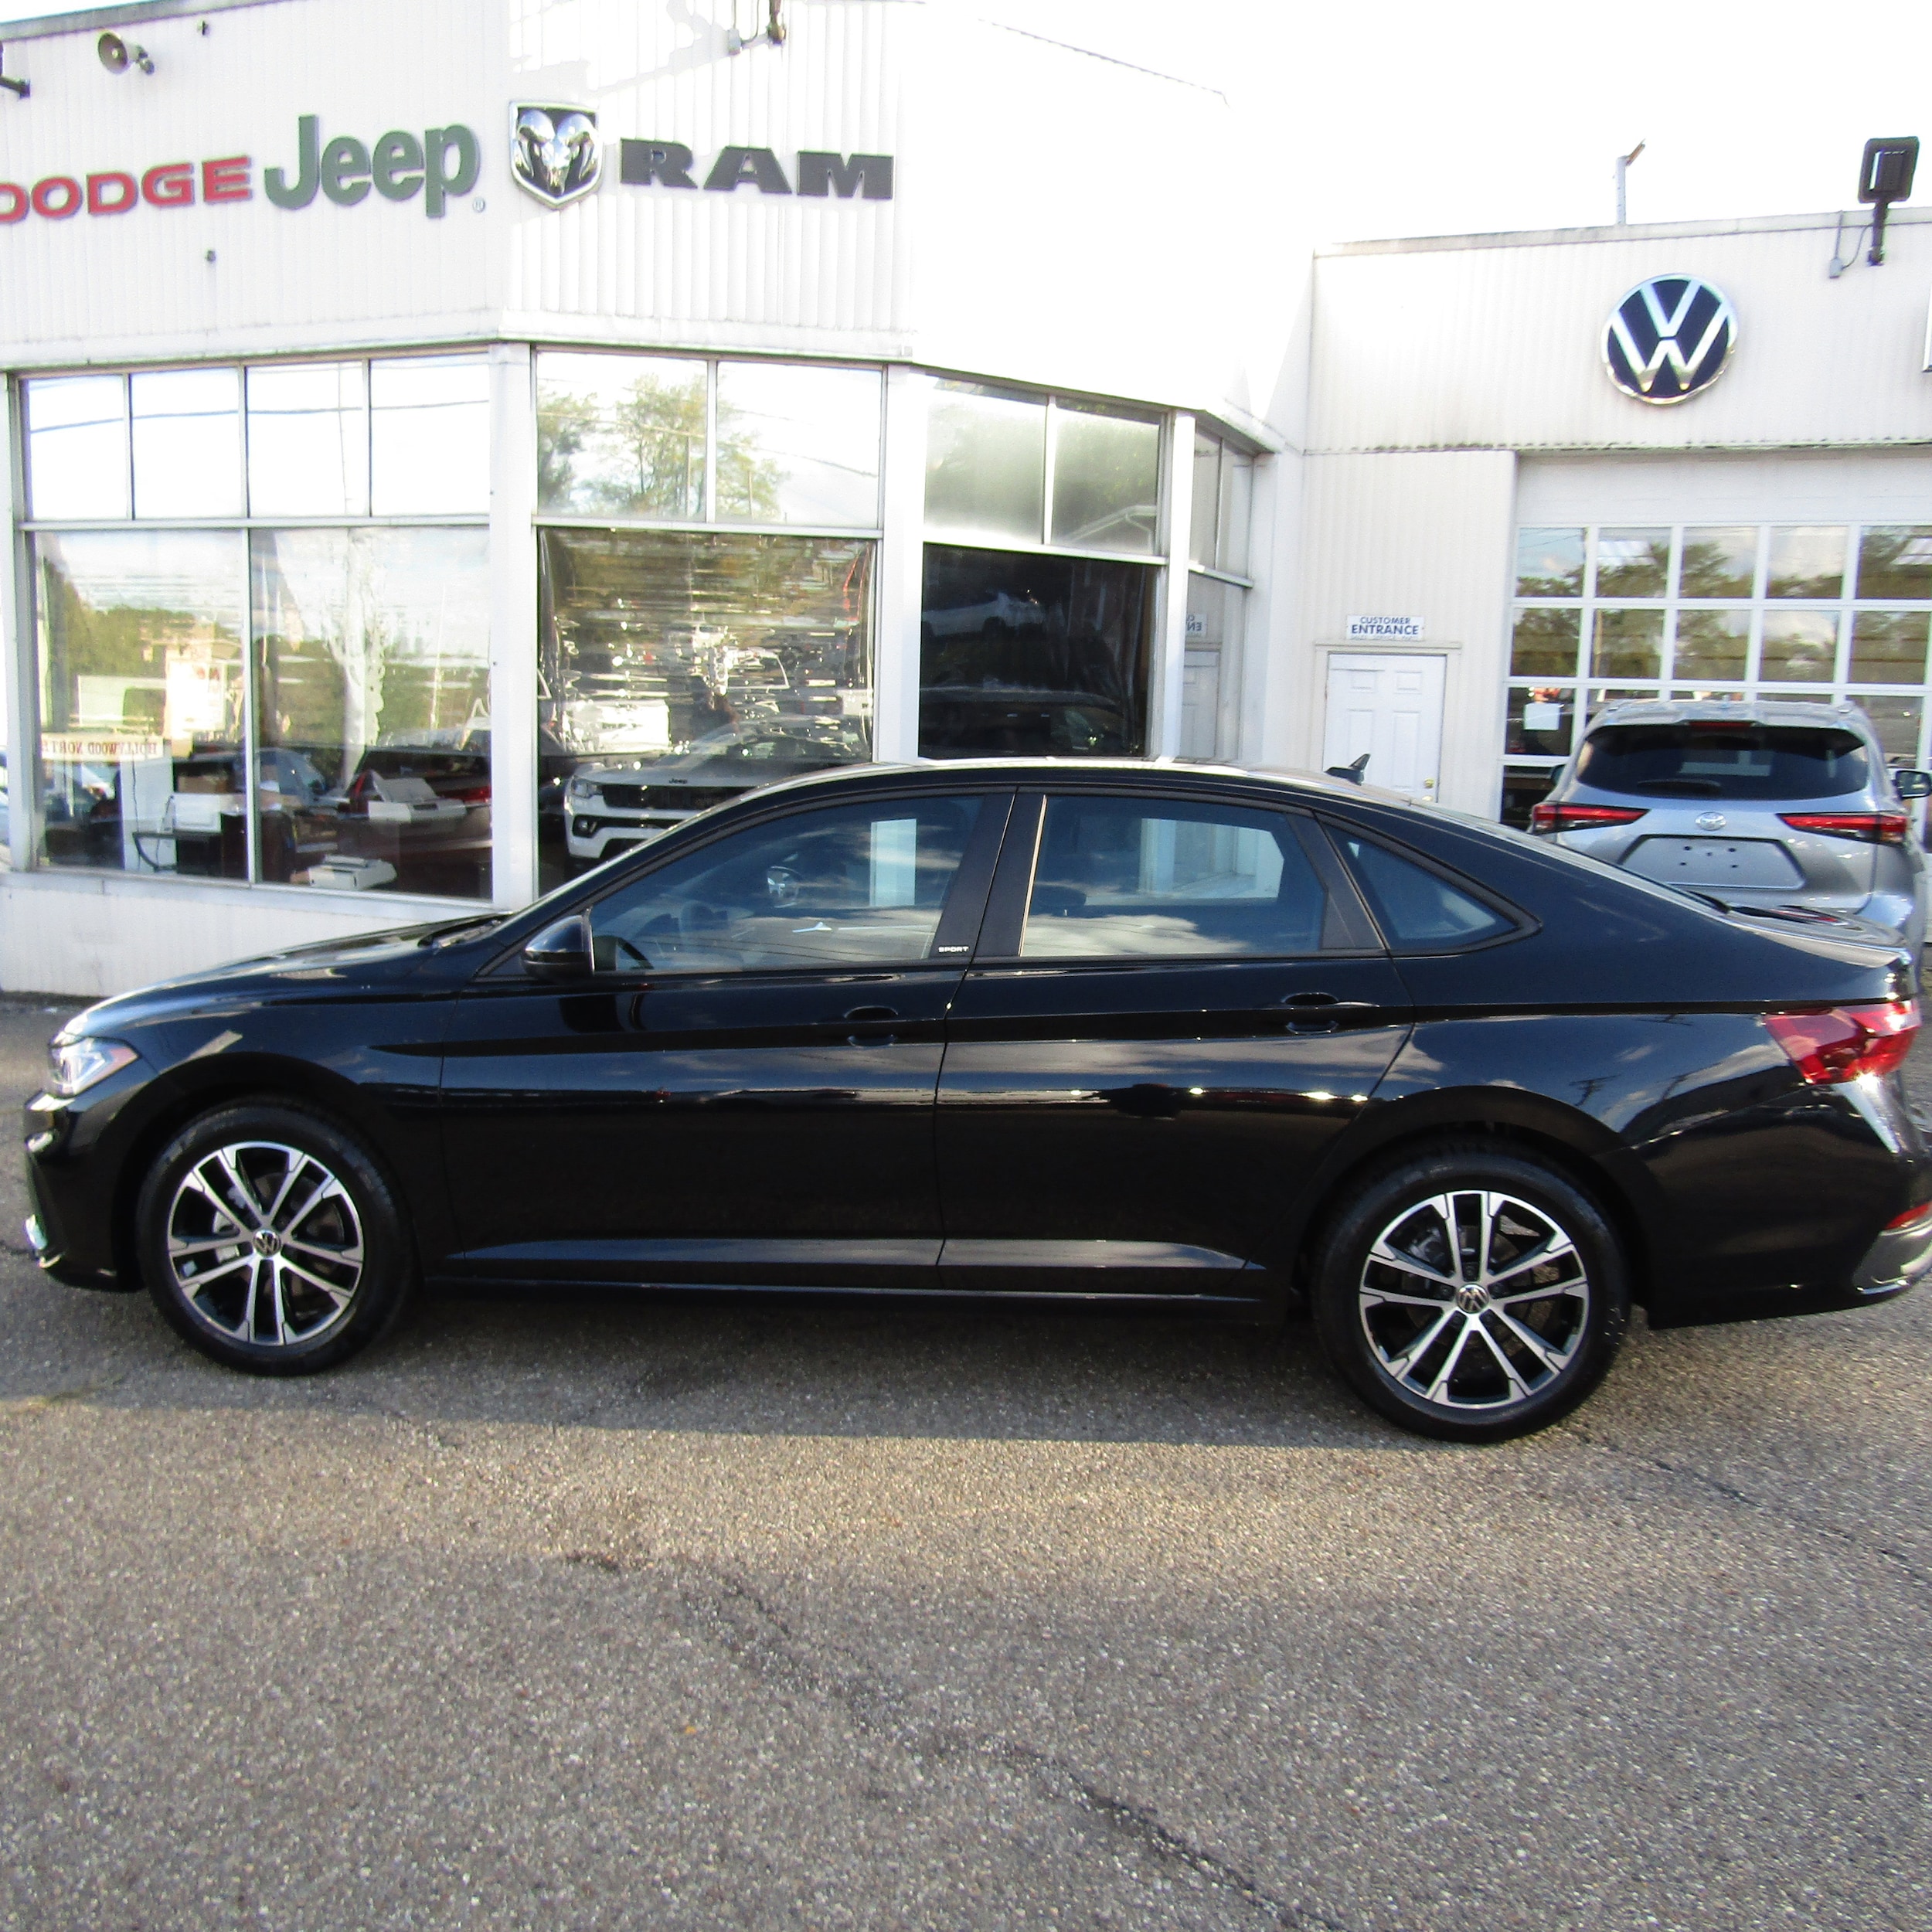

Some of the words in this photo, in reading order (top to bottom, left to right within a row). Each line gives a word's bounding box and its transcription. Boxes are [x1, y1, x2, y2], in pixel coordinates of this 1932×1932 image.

[0, 155, 253, 224] DODGE
[264, 114, 481, 219] Jeep
[619, 137, 894, 199] RAM
[1351, 624, 1420, 634] ENTRANCE
